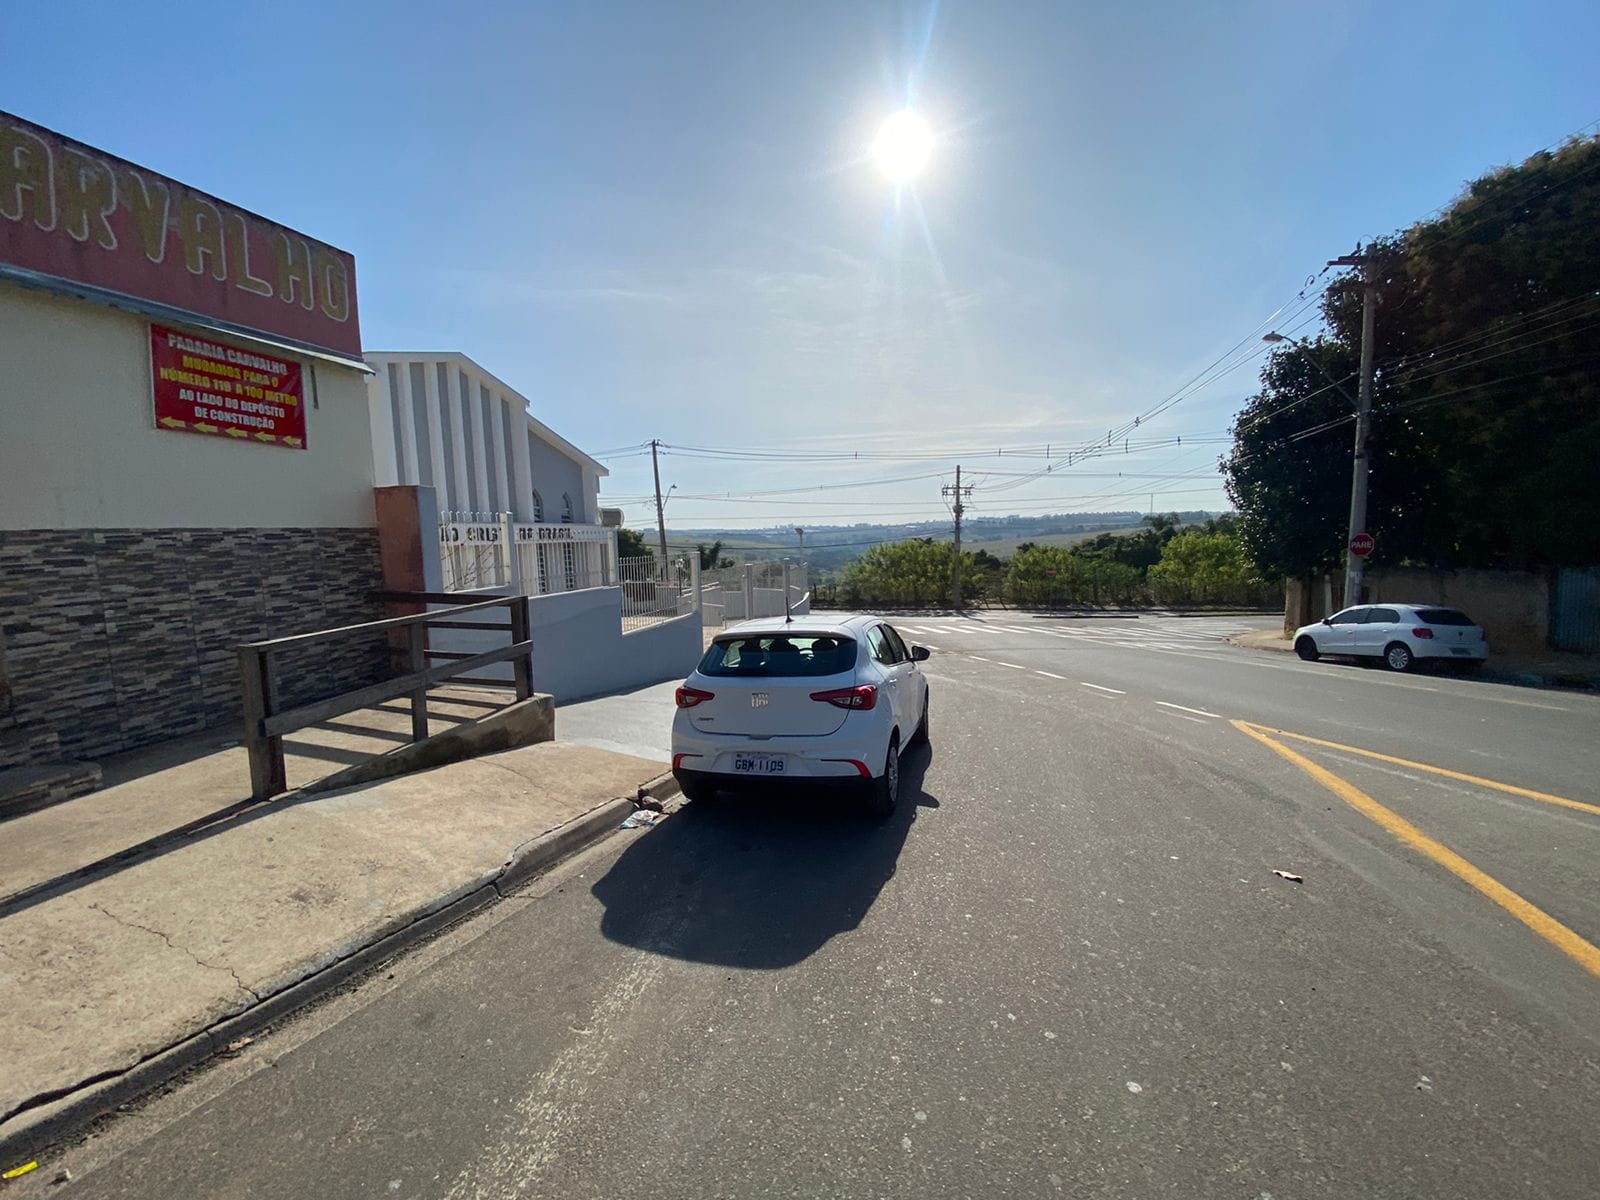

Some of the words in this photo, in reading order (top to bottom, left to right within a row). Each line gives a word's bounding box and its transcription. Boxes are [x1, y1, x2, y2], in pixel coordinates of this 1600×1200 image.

[168, 334, 225, 360] PADARIA
[228, 350, 288, 375] CARVALHO
[243, 370, 270, 386] PARA
[236, 383, 243, 395] A
[179, 388, 194, 401] AO
[196, 392, 223, 407] LADO
[225, 397, 239, 410] DO
[241, 399, 285, 418] DEPÓSITO
[194, 406, 208, 419] DE
[210, 408, 275, 430] CONSTRUÇÃO
[1351, 541, 1372, 549] PARE
